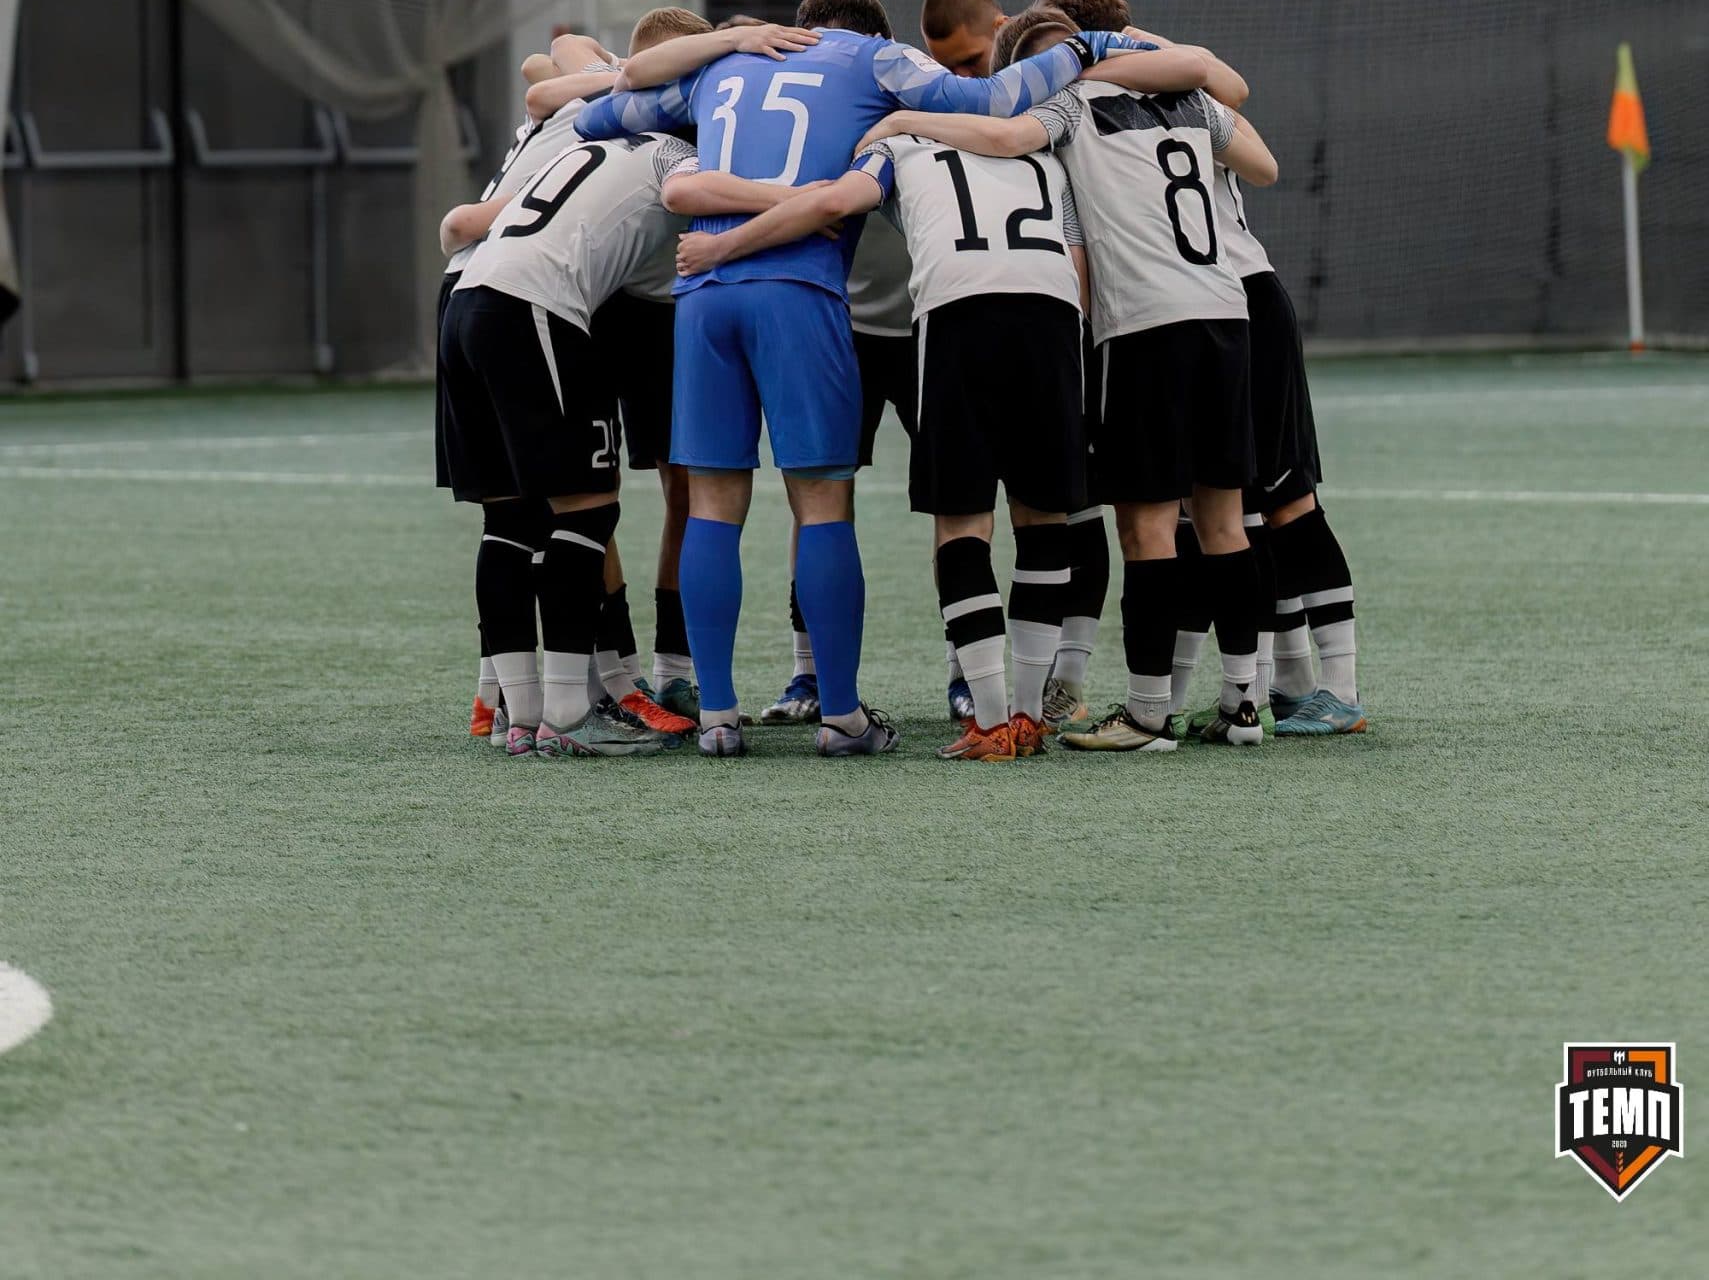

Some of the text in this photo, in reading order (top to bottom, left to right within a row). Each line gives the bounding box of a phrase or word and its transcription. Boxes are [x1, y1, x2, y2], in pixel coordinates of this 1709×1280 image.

[711, 72, 824, 186] 35
[500, 144, 606, 238] 9
[933, 149, 1065, 256] 12
[1156, 138, 1217, 266] 8
